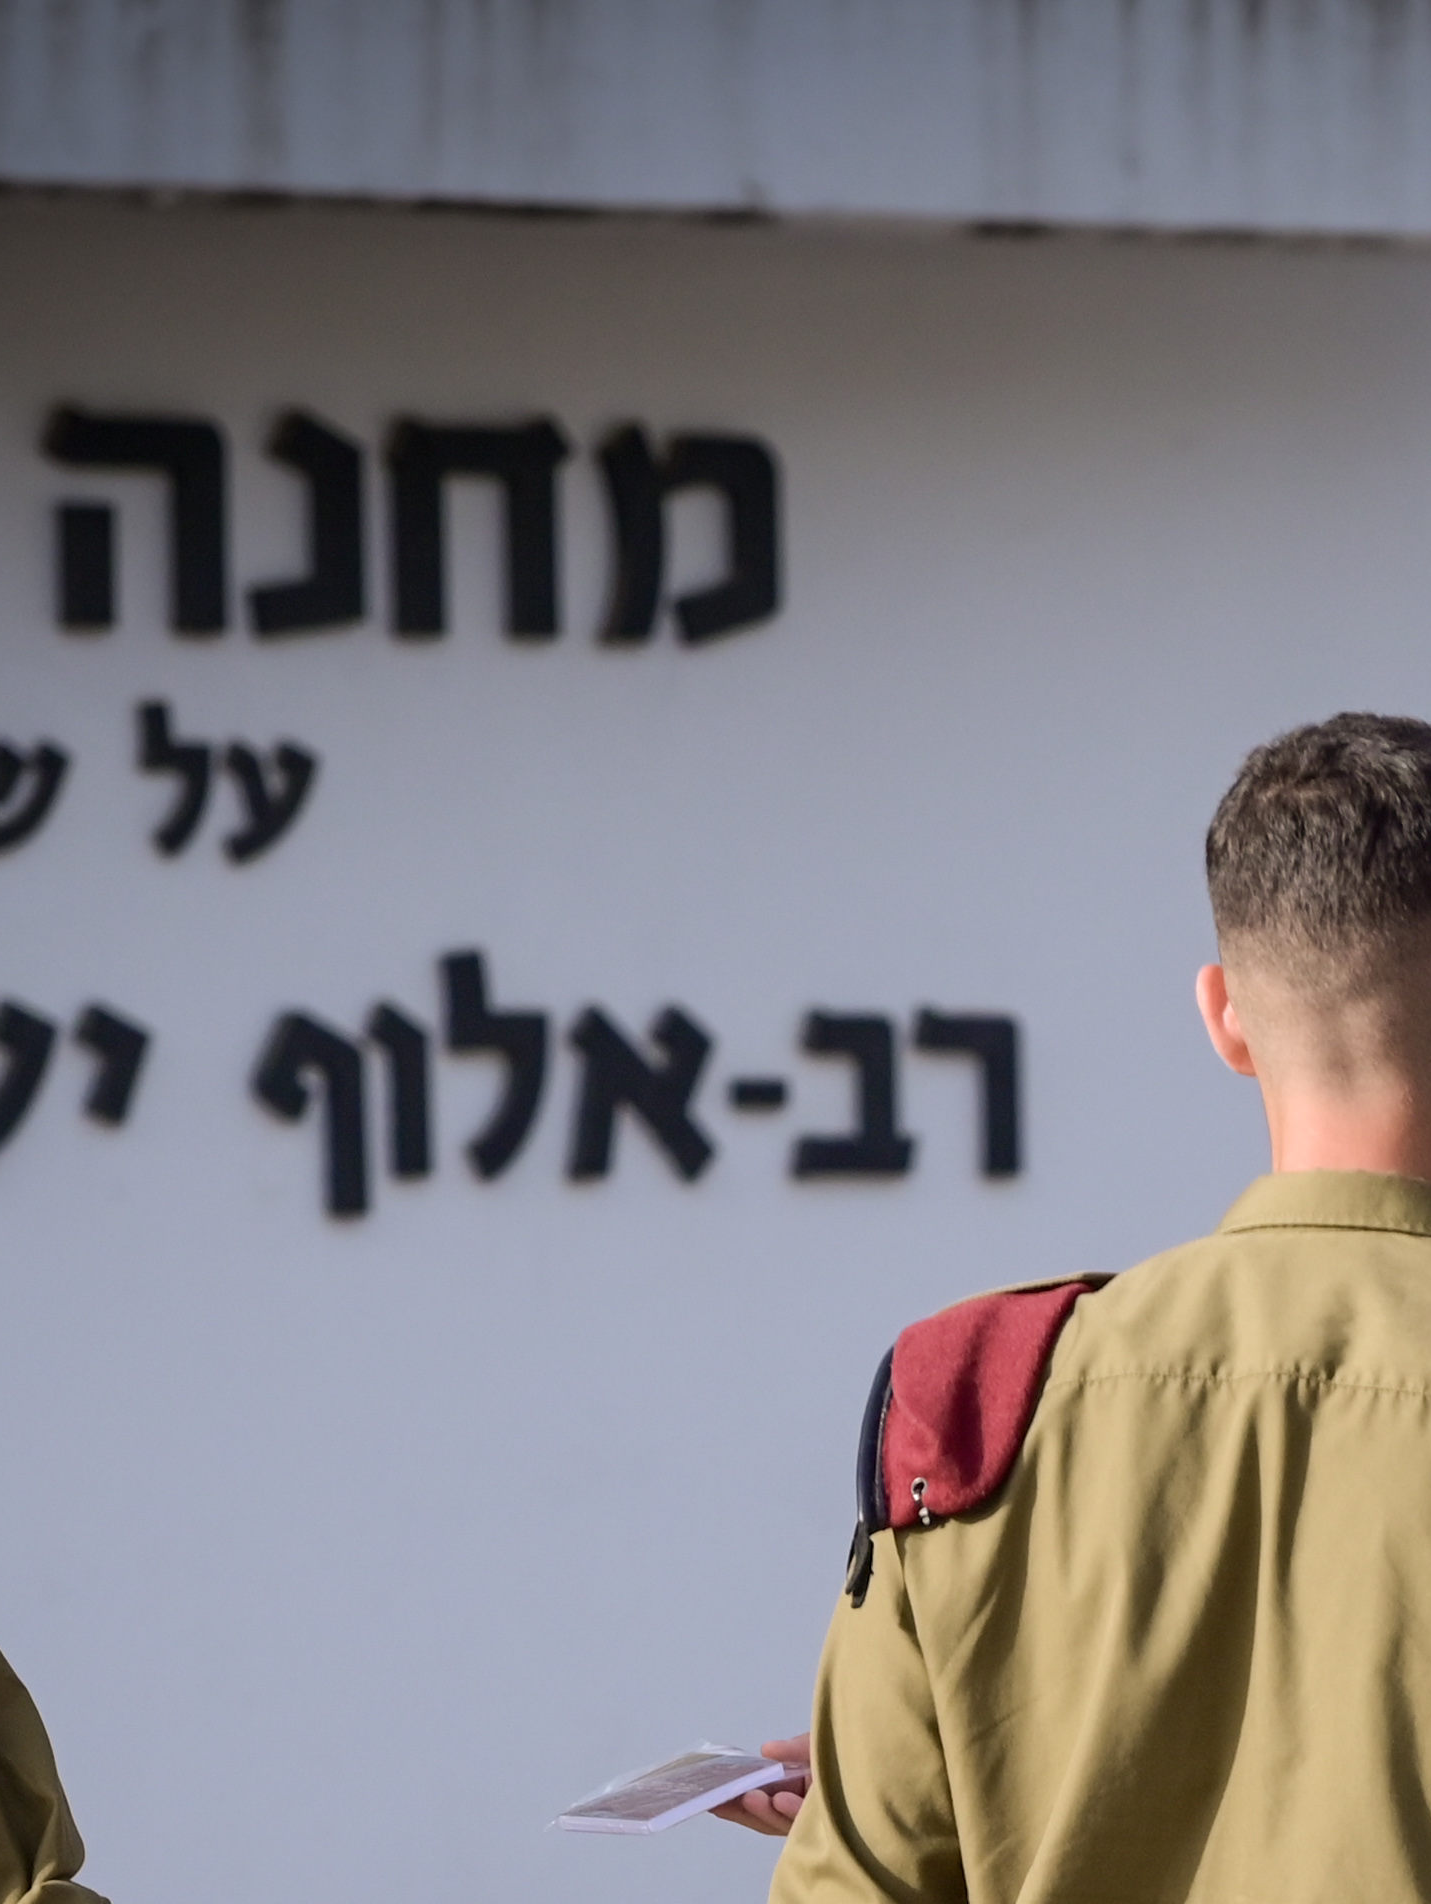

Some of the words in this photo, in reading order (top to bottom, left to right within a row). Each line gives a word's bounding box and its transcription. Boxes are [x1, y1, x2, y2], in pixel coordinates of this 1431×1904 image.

[35, 404, 783, 645] מחנה
[133, 698, 319, 864] על
[250, 948, 1024, 1220] רב-אלוף
